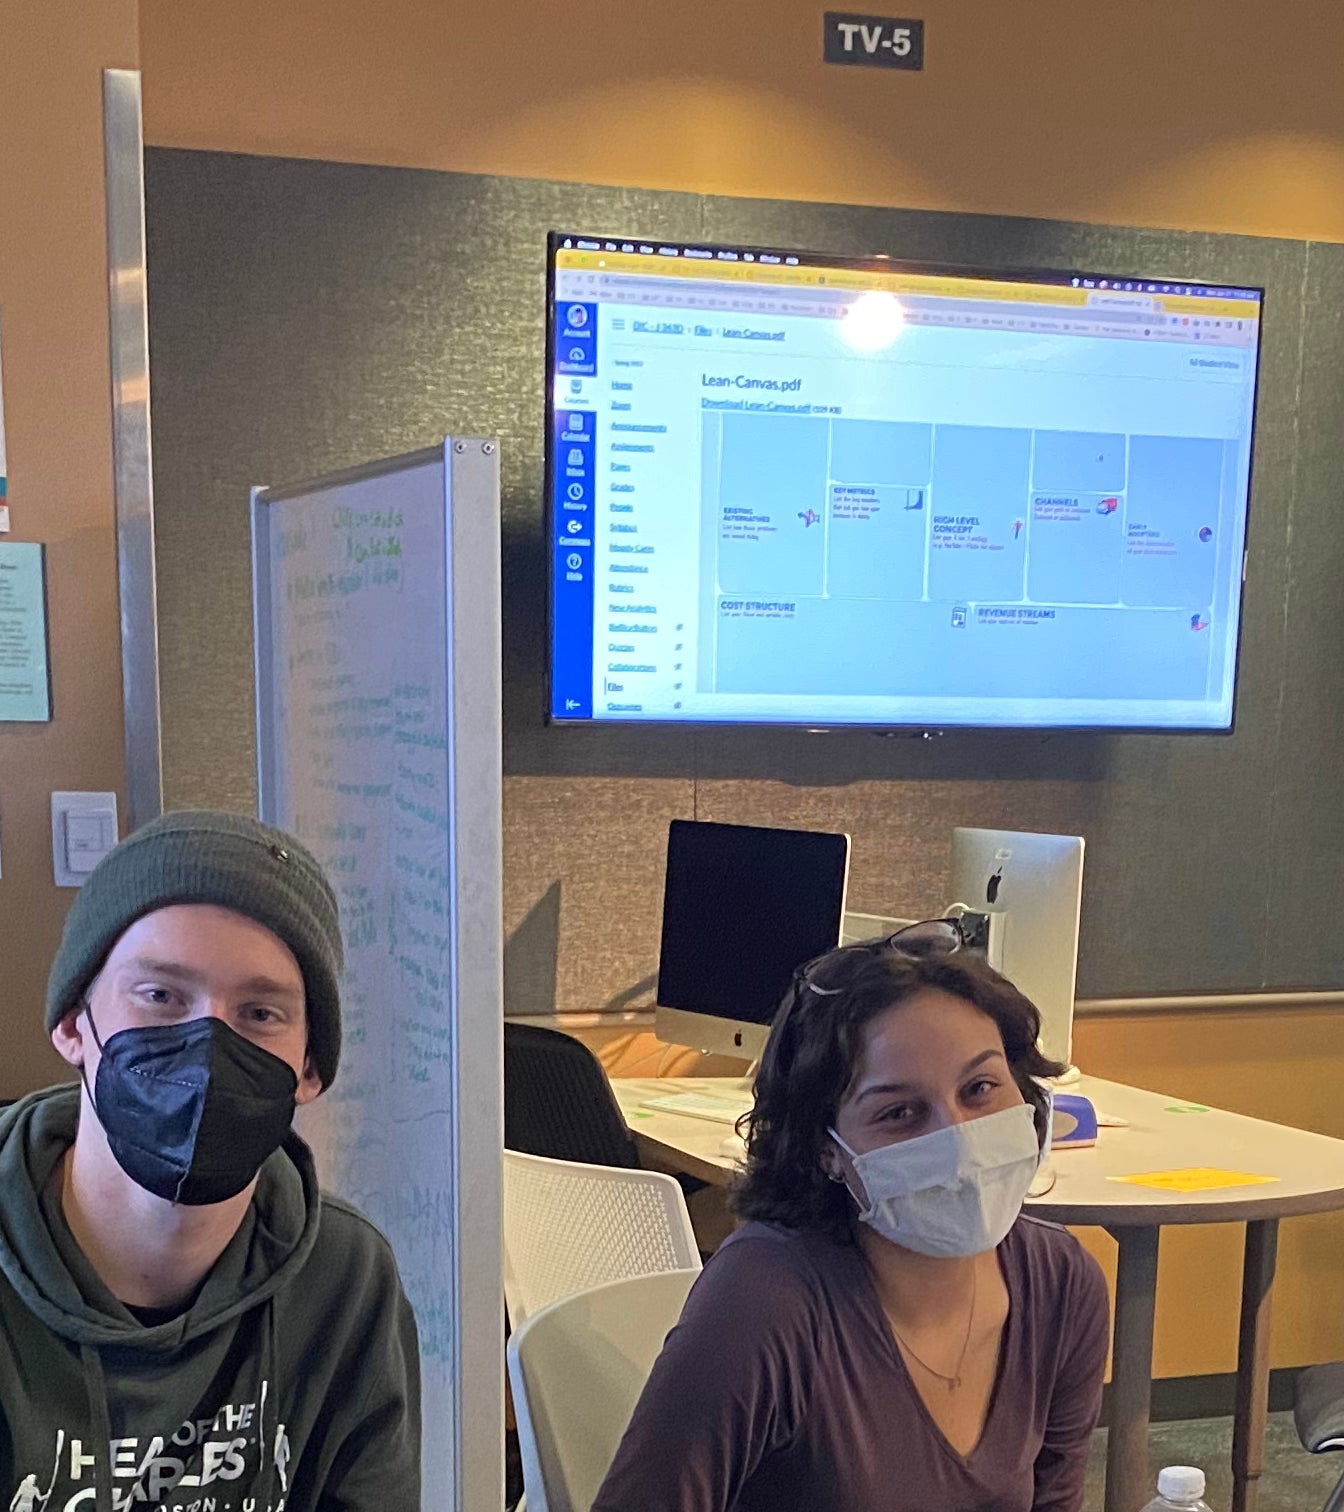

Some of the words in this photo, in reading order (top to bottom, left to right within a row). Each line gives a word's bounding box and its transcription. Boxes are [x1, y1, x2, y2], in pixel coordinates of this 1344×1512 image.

[838, 23, 911, 56] TV-5
[702, 374, 802, 392] Lean-Canvas.pdf
[1034, 497, 1079, 507] CHANNELS
[956, 517, 981, 526] LEVEL
[933, 525, 974, 534] CONCEPT
[720, 601, 743, 611] COST
[745, 602, 796, 613] STRUCTURE
[978, 608, 1016, 619] REVENUE
[1018, 609, 1056, 620] STREAMS
